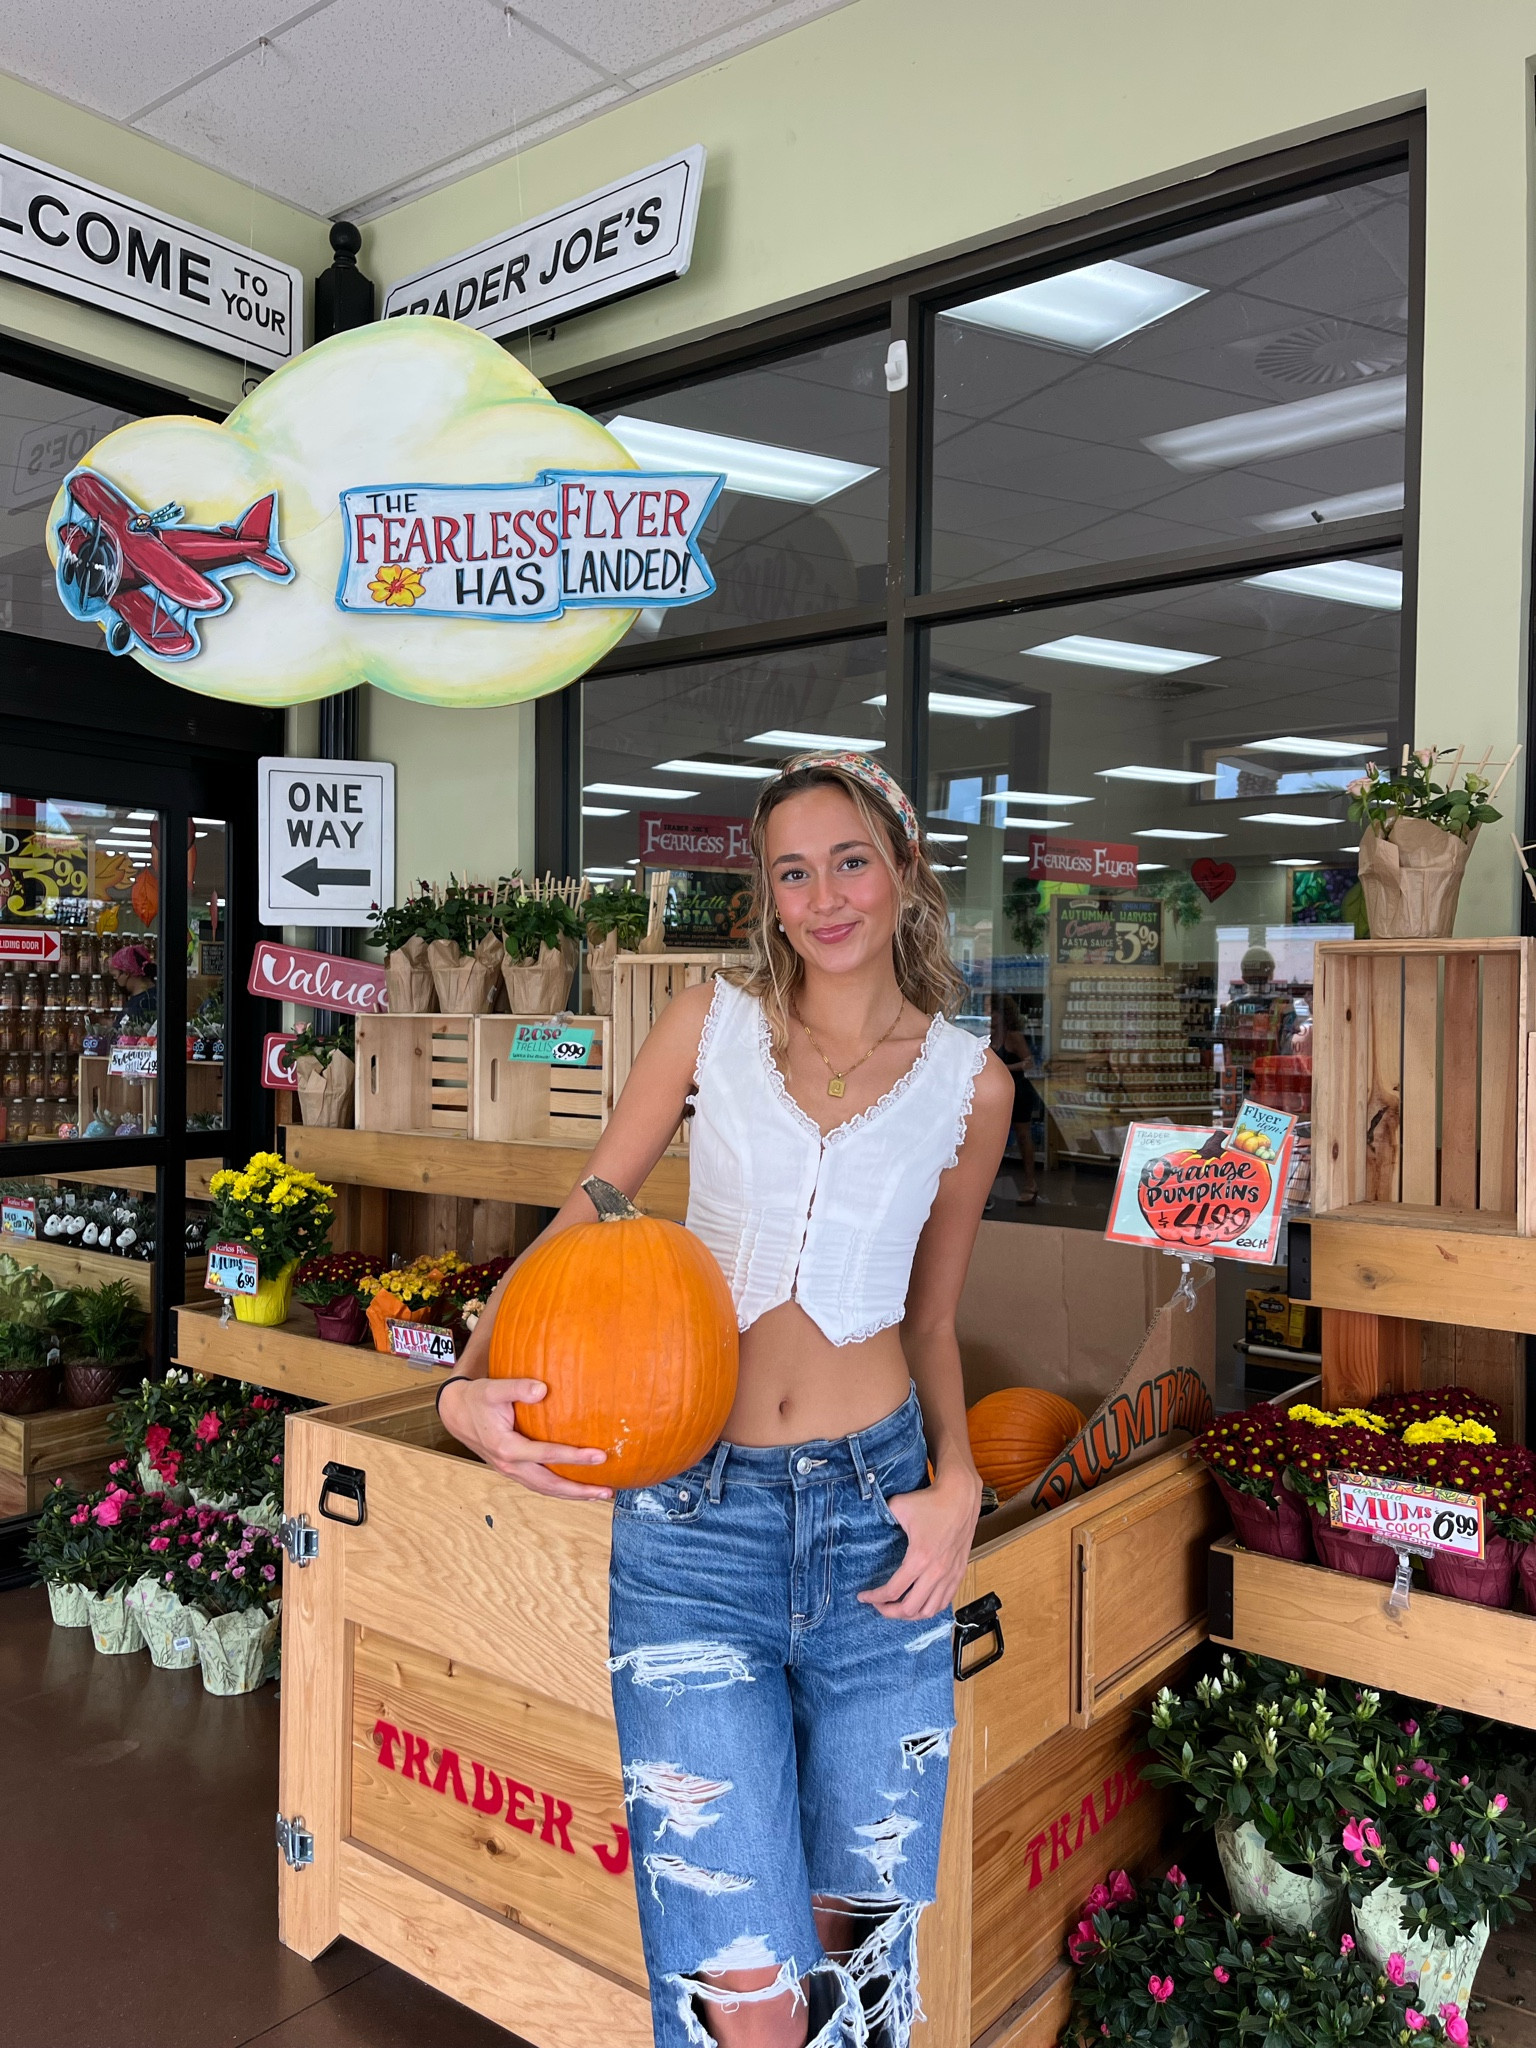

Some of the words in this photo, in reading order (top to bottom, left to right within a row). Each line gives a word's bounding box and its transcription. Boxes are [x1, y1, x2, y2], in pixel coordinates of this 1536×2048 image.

[539, 196, 662, 285] JOE'S
[234, 267, 268, 297] TO
[221, 288, 285, 336] YOUR
[366, 493, 418, 513] THE
[355, 509, 558, 563] FEARLESS
[561, 483, 691, 539] FLYER
[456, 562, 544, 605] HAS
[562, 547, 693, 594] LANDED!
[288, 781, 363, 813] ONE
[286, 818, 364, 849] WAY
[643, 818, 725, 855] FEARLESS
[725, 824, 755, 860] FL
[1031, 842, 1093, 872] FEARLESS
[1092, 848, 1136, 878] FLYER
[1061, 909, 1115, 921] AUTUMNAL
[1120, 911, 1158, 922] HARVEST
[21, 941, 39, 950] DOOR
[1062, 937, 1088, 946] PASTA
[1090, 939, 1114, 947] SAUCE
[516, 1040, 553, 1053] TRELLIS
[1243, 1105, 1282, 1125] Flyer
[1137, 1130, 1170, 1139] TRADER
[1141, 1156, 1256, 1189] Orange
[1343, 1492, 1432, 1521] MUMS
[1352, 1487, 1405, 1502] assorted
[1344, 1510, 1383, 1531] FALL
[1386, 1521, 1431, 1540] COLOR
[1375, 1529, 1443, 1549] SEASONAL
[373, 1719, 576, 1855] TRADER
[1023, 1751, 1146, 1893] TRADE
